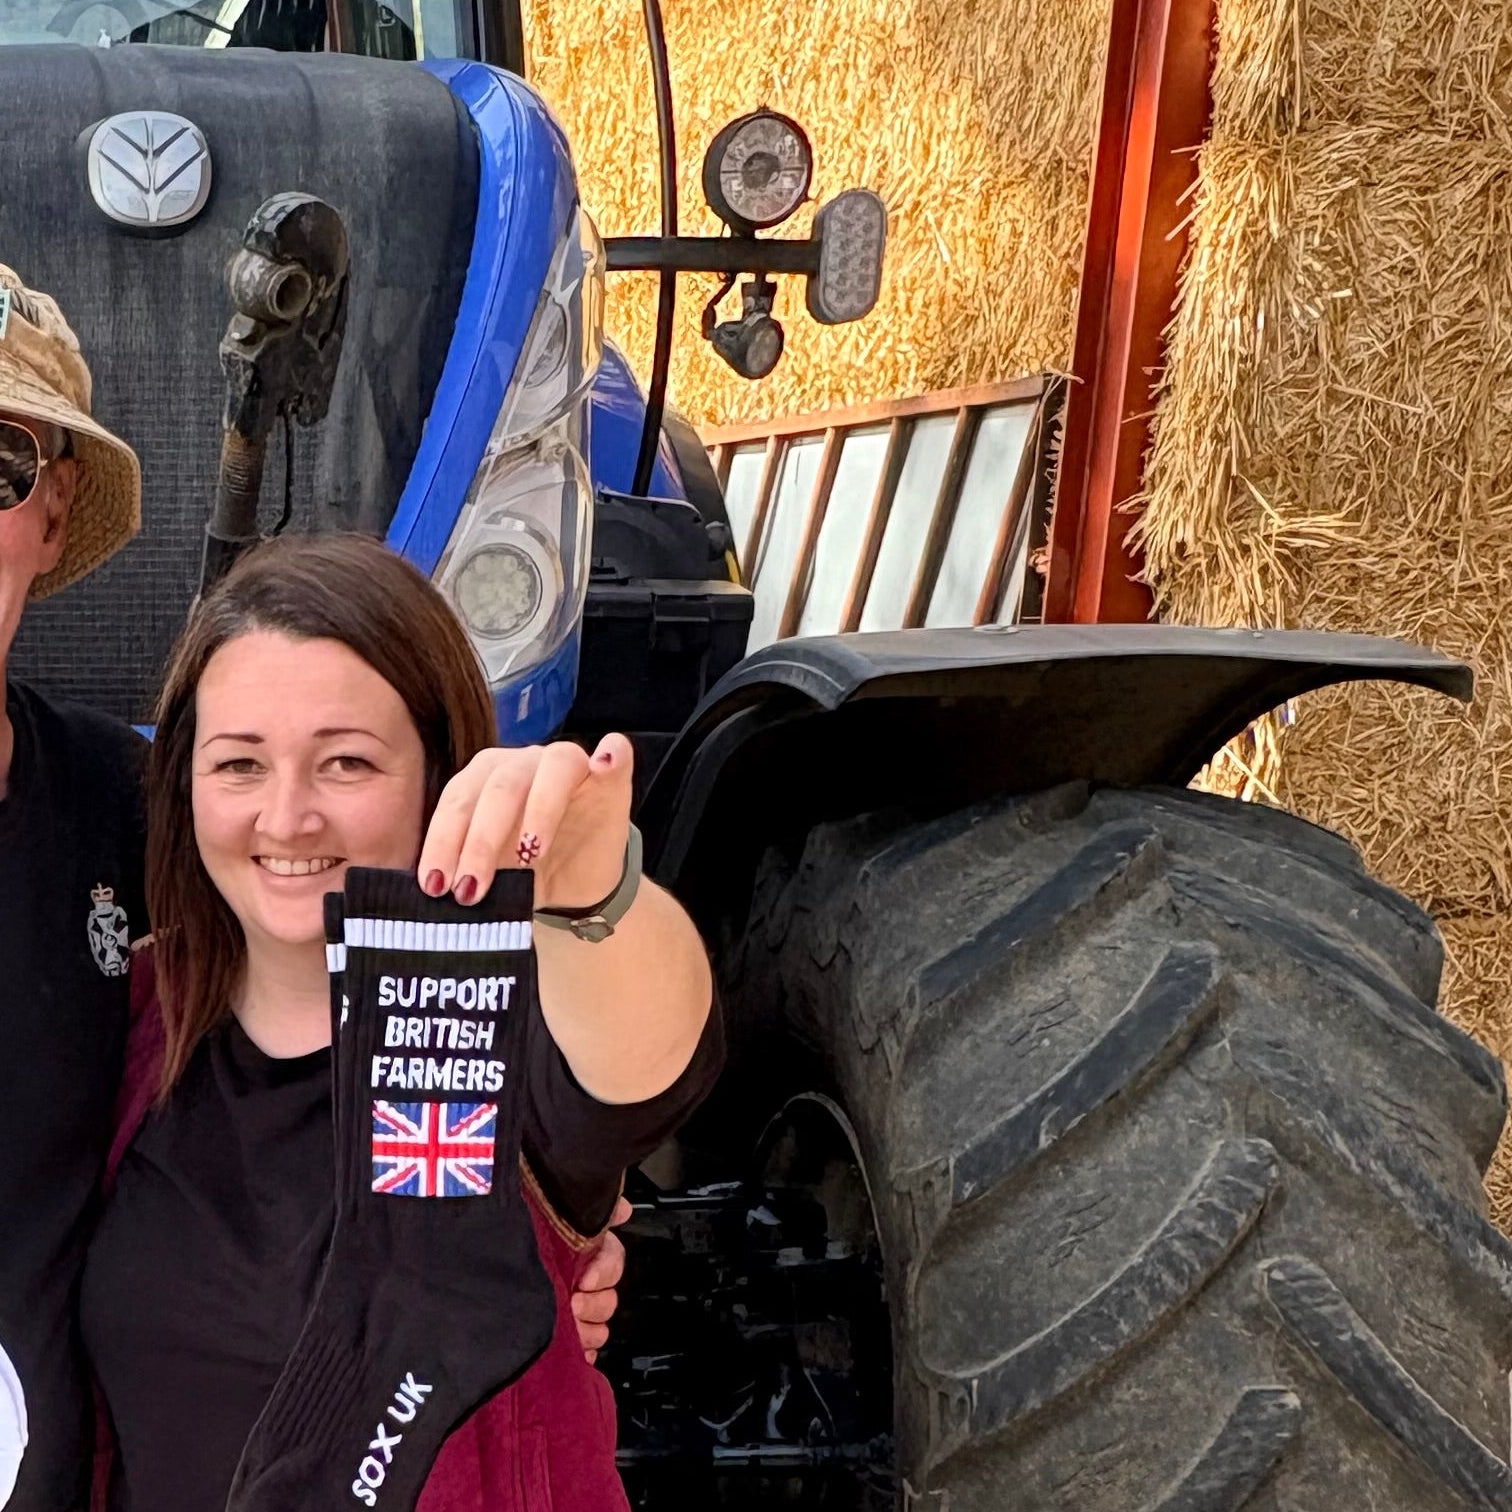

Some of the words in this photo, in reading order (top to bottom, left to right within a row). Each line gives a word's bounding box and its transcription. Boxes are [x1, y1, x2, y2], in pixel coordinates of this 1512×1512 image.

[378, 975, 516, 1012] SUPPORT
[384, 1015, 496, 1050] BRITISH
[370, 1054, 506, 1092] FARMERS
[351, 1422, 403, 1507] SOX
[387, 1371, 433, 1423] UK
